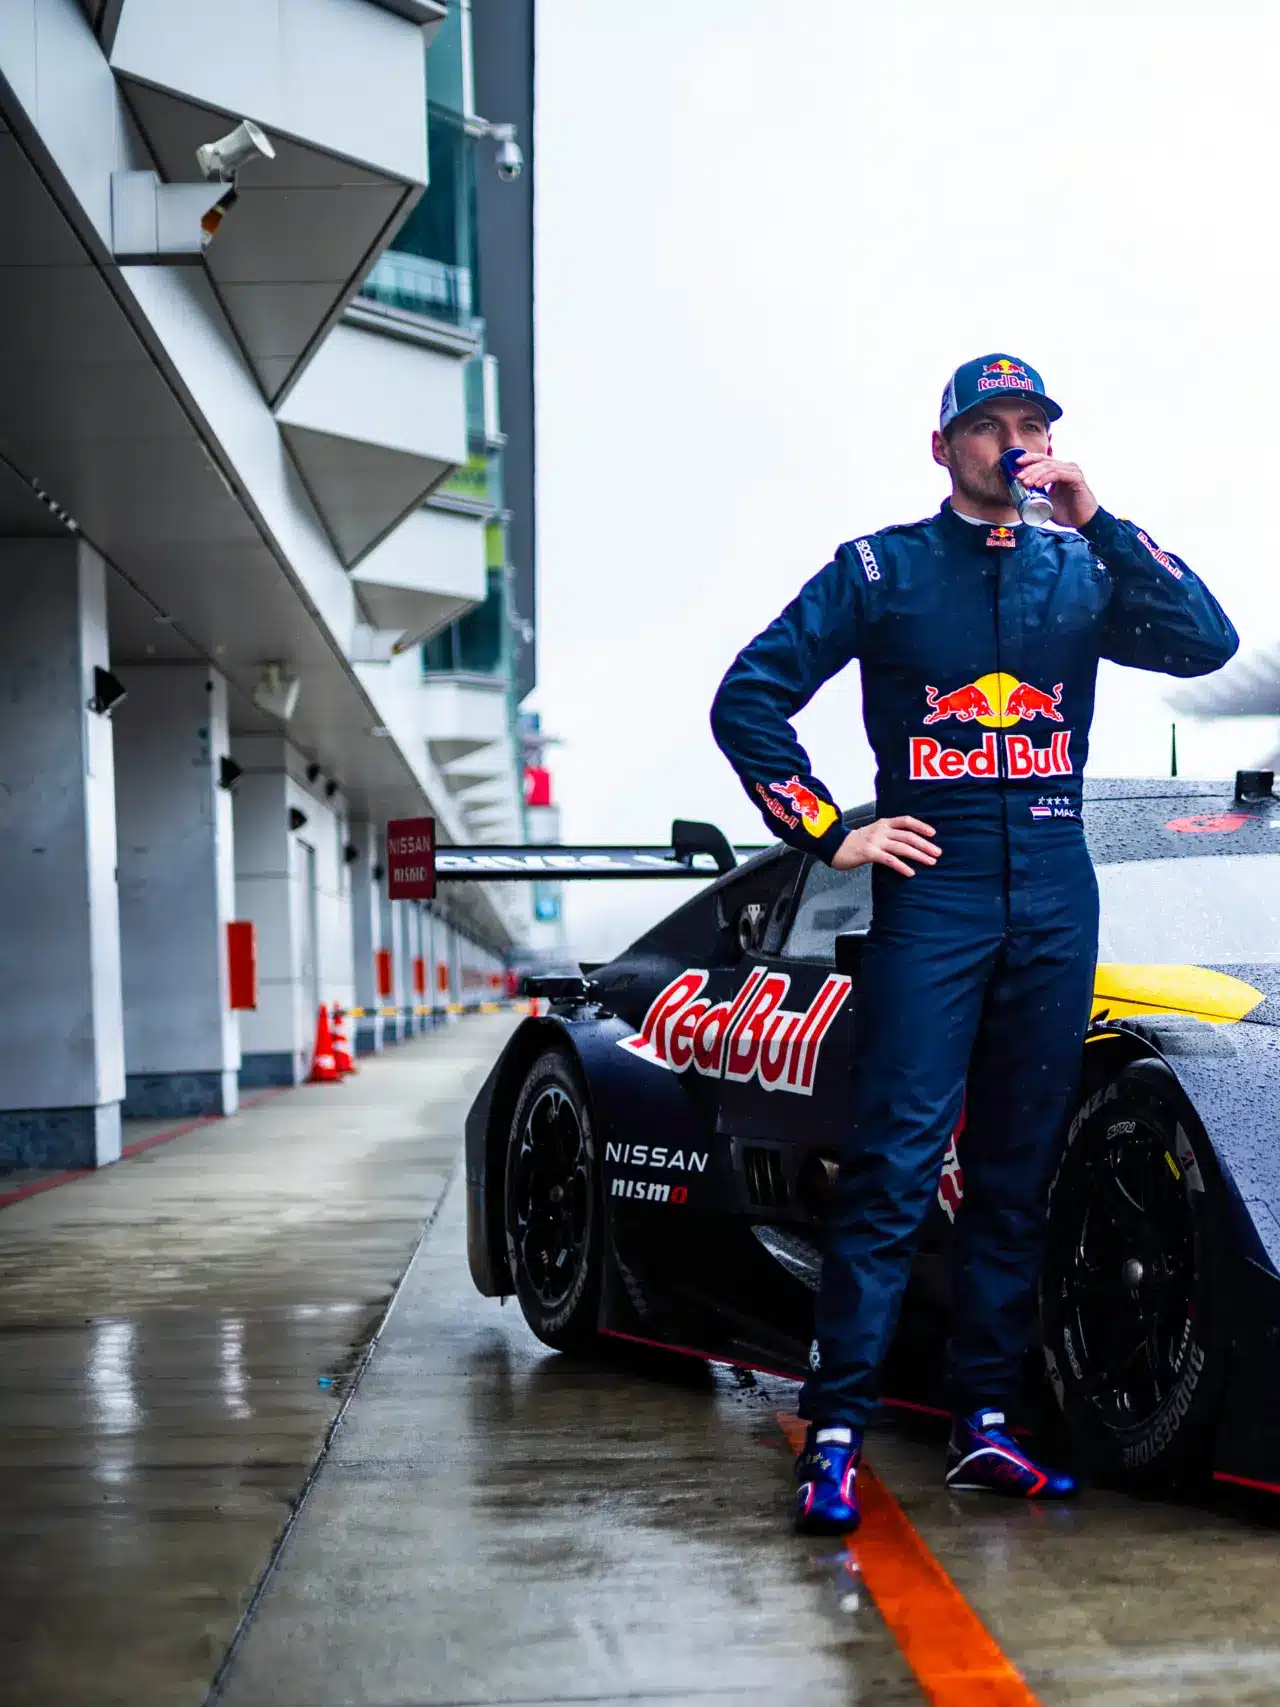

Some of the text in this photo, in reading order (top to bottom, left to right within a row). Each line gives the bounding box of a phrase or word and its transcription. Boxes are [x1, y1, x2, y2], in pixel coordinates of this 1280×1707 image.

[978, 375, 1034, 391] Red Bull
[856, 540, 881, 581] sparco
[909, 731, 1073, 780] Red Bull
[773, 800, 800, 830] Bull
[388, 836, 431, 855] NISSAN
[616, 966, 852, 1096] Red Bull
[605, 1141, 709, 1173] NISSAN
[611, 1178, 688, 1204] nismo
[1122, 1339, 1205, 1468] BRIDGESTONE
